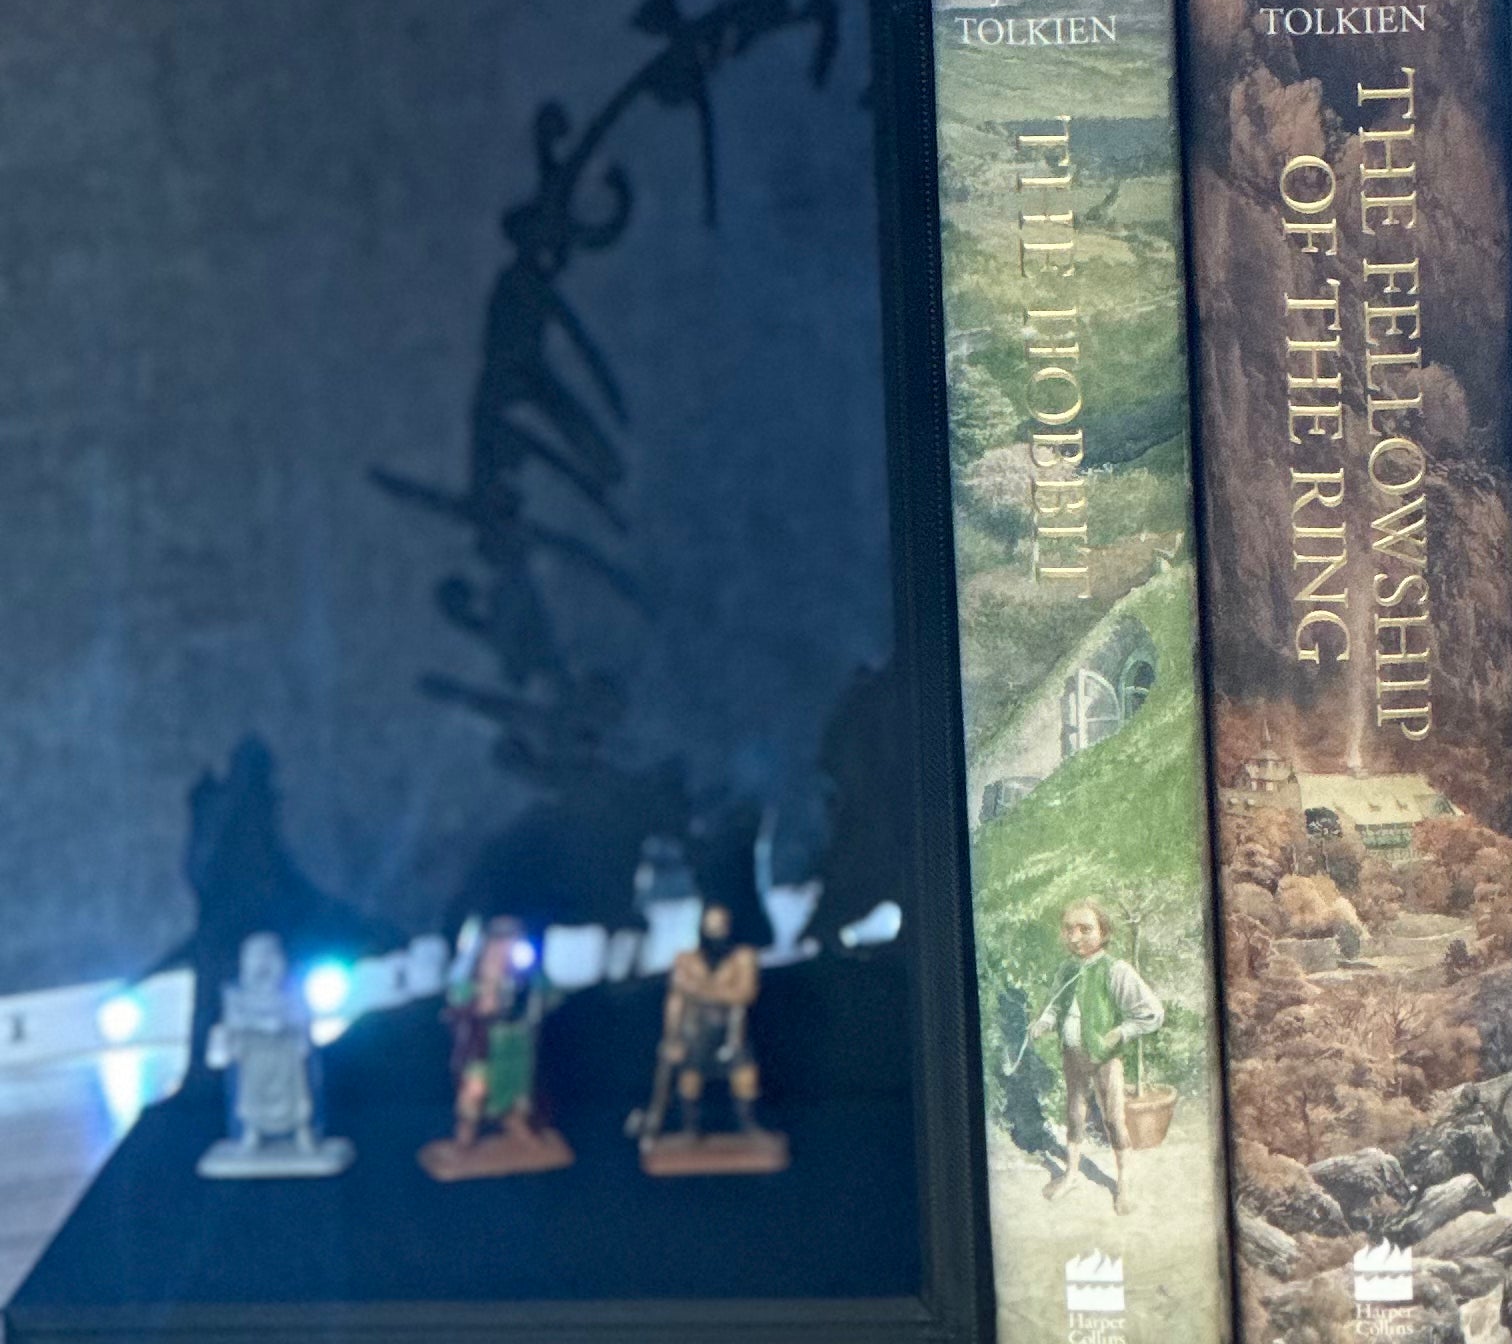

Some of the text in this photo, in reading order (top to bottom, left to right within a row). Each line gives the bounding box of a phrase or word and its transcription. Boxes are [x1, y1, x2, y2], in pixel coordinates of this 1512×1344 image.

[954, 15, 1117, 46] TOLKIEN
[1259, 4, 1427, 36] TOLKIEN
[1016, 113, 1092, 599] THE HOBBIT
[1278, 154, 1352, 666] OF THE RING
[1356, 67, 1433, 743] THE FELLOWSHIP
[1069, 1311, 1126, 1333] Harper
